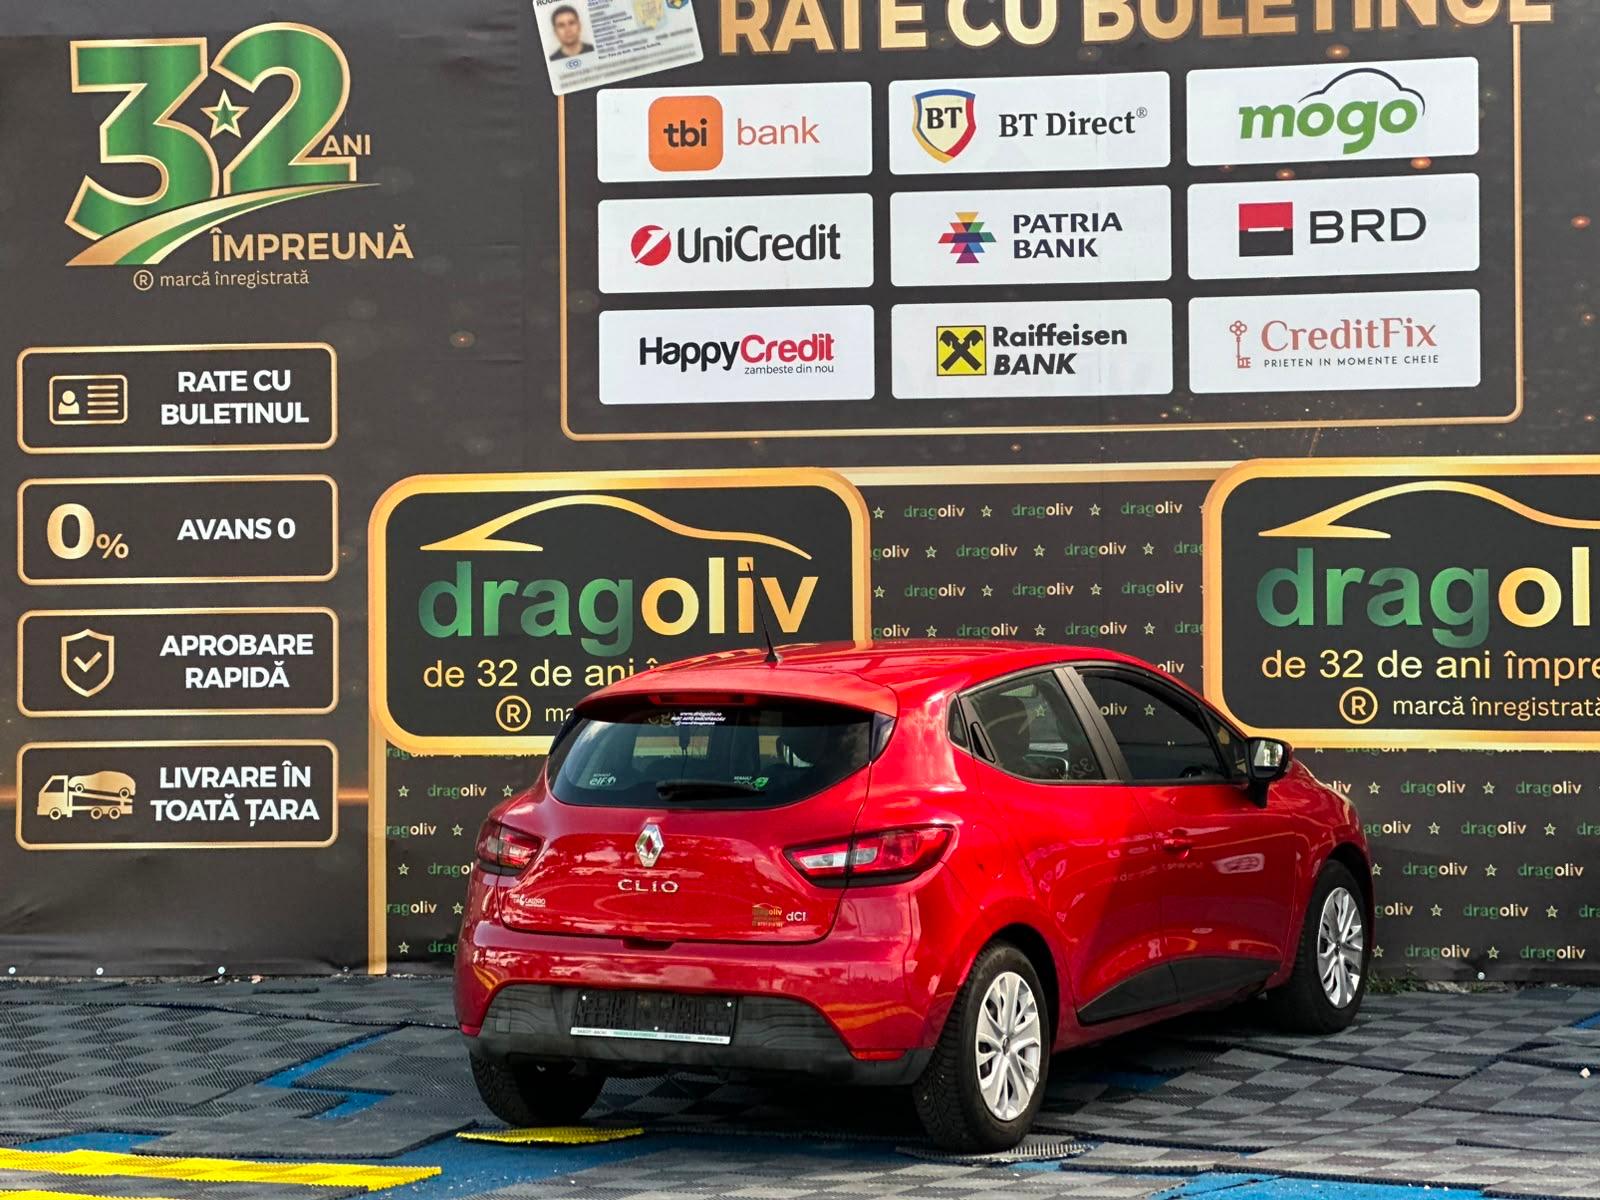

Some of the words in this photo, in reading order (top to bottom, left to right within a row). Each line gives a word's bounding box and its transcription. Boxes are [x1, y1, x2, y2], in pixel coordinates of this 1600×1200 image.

[947, 0, 1057, 48] CU
[926, 107, 964, 130] BT
[998, 113, 1037, 138] BT
[1239, 99, 1418, 155] mogo
[664, 118, 708, 148] tbi
[737, 116, 820, 146] bank
[321, 134, 371, 156] ANI
[1013, 211, 1123, 234] PATRIA
[1309, 207, 1427, 245] BRD
[209, 223, 414, 262] ÎMPREUNĂ
[677, 223, 841, 264] UniCredit
[1013, 238, 1099, 259] BANK
[160, 270, 211, 287] marcă
[215, 269, 310, 289] înregistrată
[992, 322, 1128, 348] Raiffeisen
[1261, 318, 1438, 352] CreditFix
[639, 333, 835, 373] HappyCredit
[1264, 358, 1313, 368] PRIETEN
[1319, 357, 1331, 367] IN
[1337, 356, 1398, 366] MOMENTE
[1403, 354, 1439, 365] CHEIE
[744, 364, 794, 375] zambeste
[795, 363, 813, 374] din
[814, 365, 834, 374] nou
[993, 352, 1078, 376] BANK
[177, 370, 248, 393] RATE
[253, 369, 291, 392] CU
[160, 402, 310, 426] BULETINUL
[904, 503, 965, 520] dragoliv
[1012, 502, 1073, 519] dragoliv
[1121, 501, 1183, 518] dragoliv
[176, 518, 272, 541] AVANS
[277, 517, 296, 540] 0
[956, 543, 1018, 560] dragoliv
[1065, 542, 1126, 559] dragoliv
[905, 583, 966, 600] dragoliv
[1013, 582, 1074, 599] dragoliv
[1122, 580, 1184, 597] dragoliv
[1256, 546, 1590, 649] dragol
[418, 556, 819, 657] dragoliv
[957, 623, 1018, 639] dragoliv
[1065, 621, 1127, 638] dragoliv
[160, 634, 314, 657] APROBARE
[185, 660, 290, 689] RAPIDĂ
[423, 659, 465, 688] de
[477, 659, 518, 688] 32
[530, 659, 572, 687] de
[584, 658, 634, 687] ani
[1261, 650, 1306, 679] de
[1319, 649, 1364, 679] 32
[1377, 649, 1423, 679] de
[1436, 650, 1491, 679] ani
[1393, 696, 1465, 716] marcă
[159, 766, 276, 789] LIVRARE
[282, 760, 312, 788] ÎN
[427, 783, 488, 800] dragoliv
[1401, 780, 1466, 797] dragoliv
[1516, 780, 1582, 797] dragoliv
[150, 793, 240, 822] TOATĂ
[1461, 820, 1527, 838] dragoliv
[1403, 861, 1468, 878] dragoliv
[1518, 862, 1585, 880] dragoliv
[617, 878, 679, 893] CLIO
[1463, 903, 1529, 920] dragoliv
[1405, 945, 1470, 962] dragoliv
[1520, 945, 1586, 963] dragoliv
